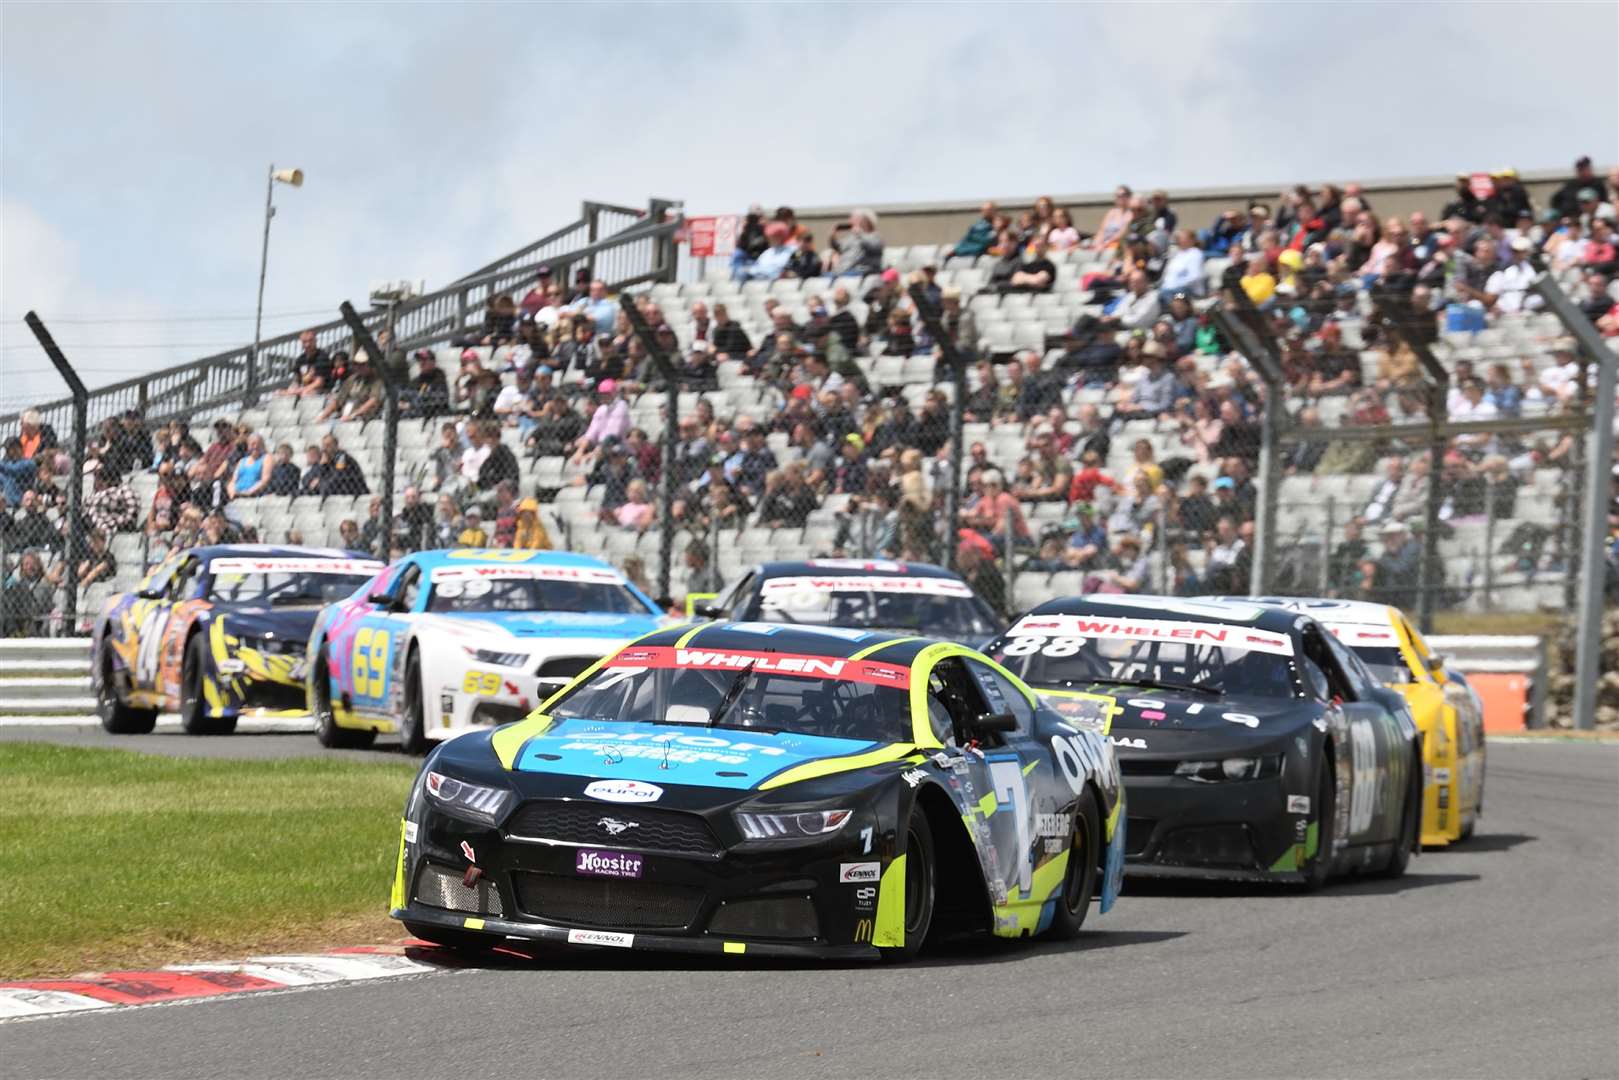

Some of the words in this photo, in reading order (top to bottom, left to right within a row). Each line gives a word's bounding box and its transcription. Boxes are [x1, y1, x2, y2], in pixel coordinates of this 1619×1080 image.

[1077, 620, 1227, 642] WHELEN
[1003, 635, 1087, 657] 88
[353, 626, 390, 699] 69
[676, 649, 848, 676] WHELEN
[462, 671, 502, 696] 69
[595, 667, 648, 690] 7
[563, 731, 787, 756] orion
[592, 784, 655, 799] eurol
[986, 759, 1032, 895] 7
[861, 827, 873, 855] 7
[577, 853, 641, 872] Hoosier
[847, 869, 876, 878] KENNOL
[580, 934, 625, 943] KENNOL
